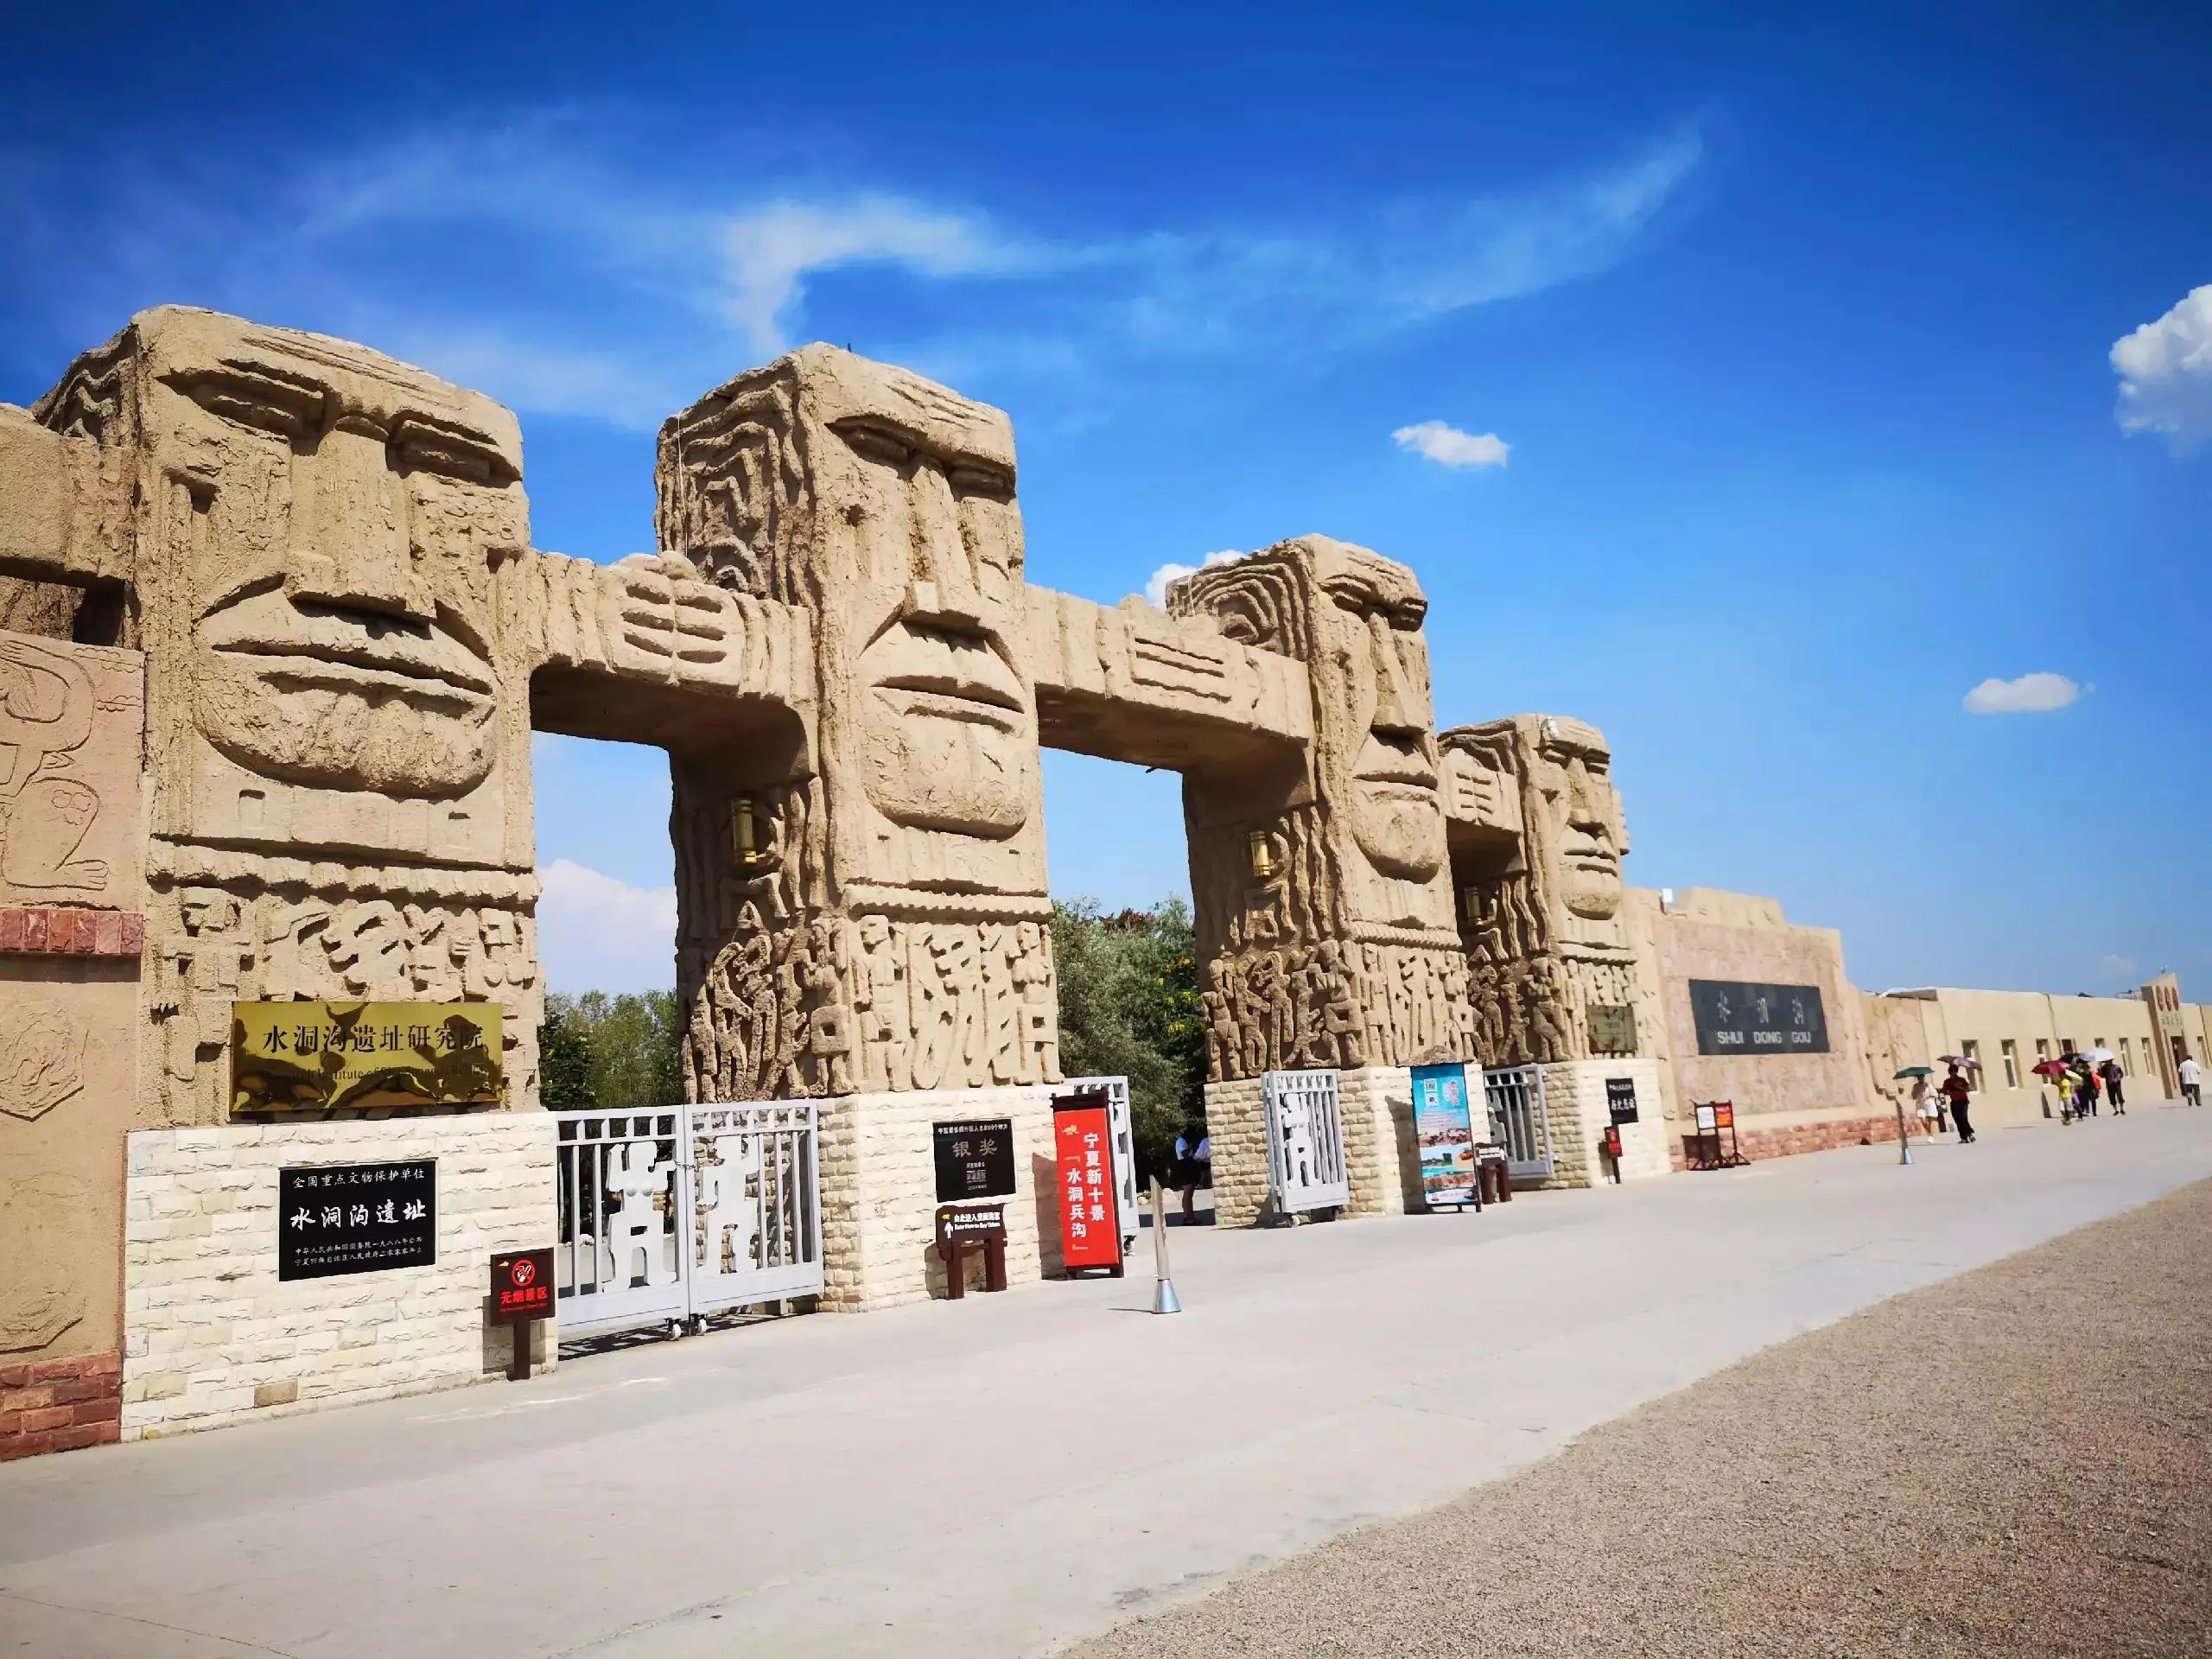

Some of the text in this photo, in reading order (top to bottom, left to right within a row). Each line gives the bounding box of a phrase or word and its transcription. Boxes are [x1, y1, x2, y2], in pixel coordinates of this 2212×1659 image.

[262, 1024, 485, 1053] 水洞沟遗址研究院
[1717, 1031, 1812, 1044] SHUI DONG GOU
[951, 1138, 998, 1158] 银奖
[292, 1168, 425, 1189] 全国重点文物保护单位
[1084, 1132, 1106, 1222] 宁夏新十景
[289, 1198, 427, 1231] 水洞沟遗址
[500, 1286, 548, 1305] 无烟景区
